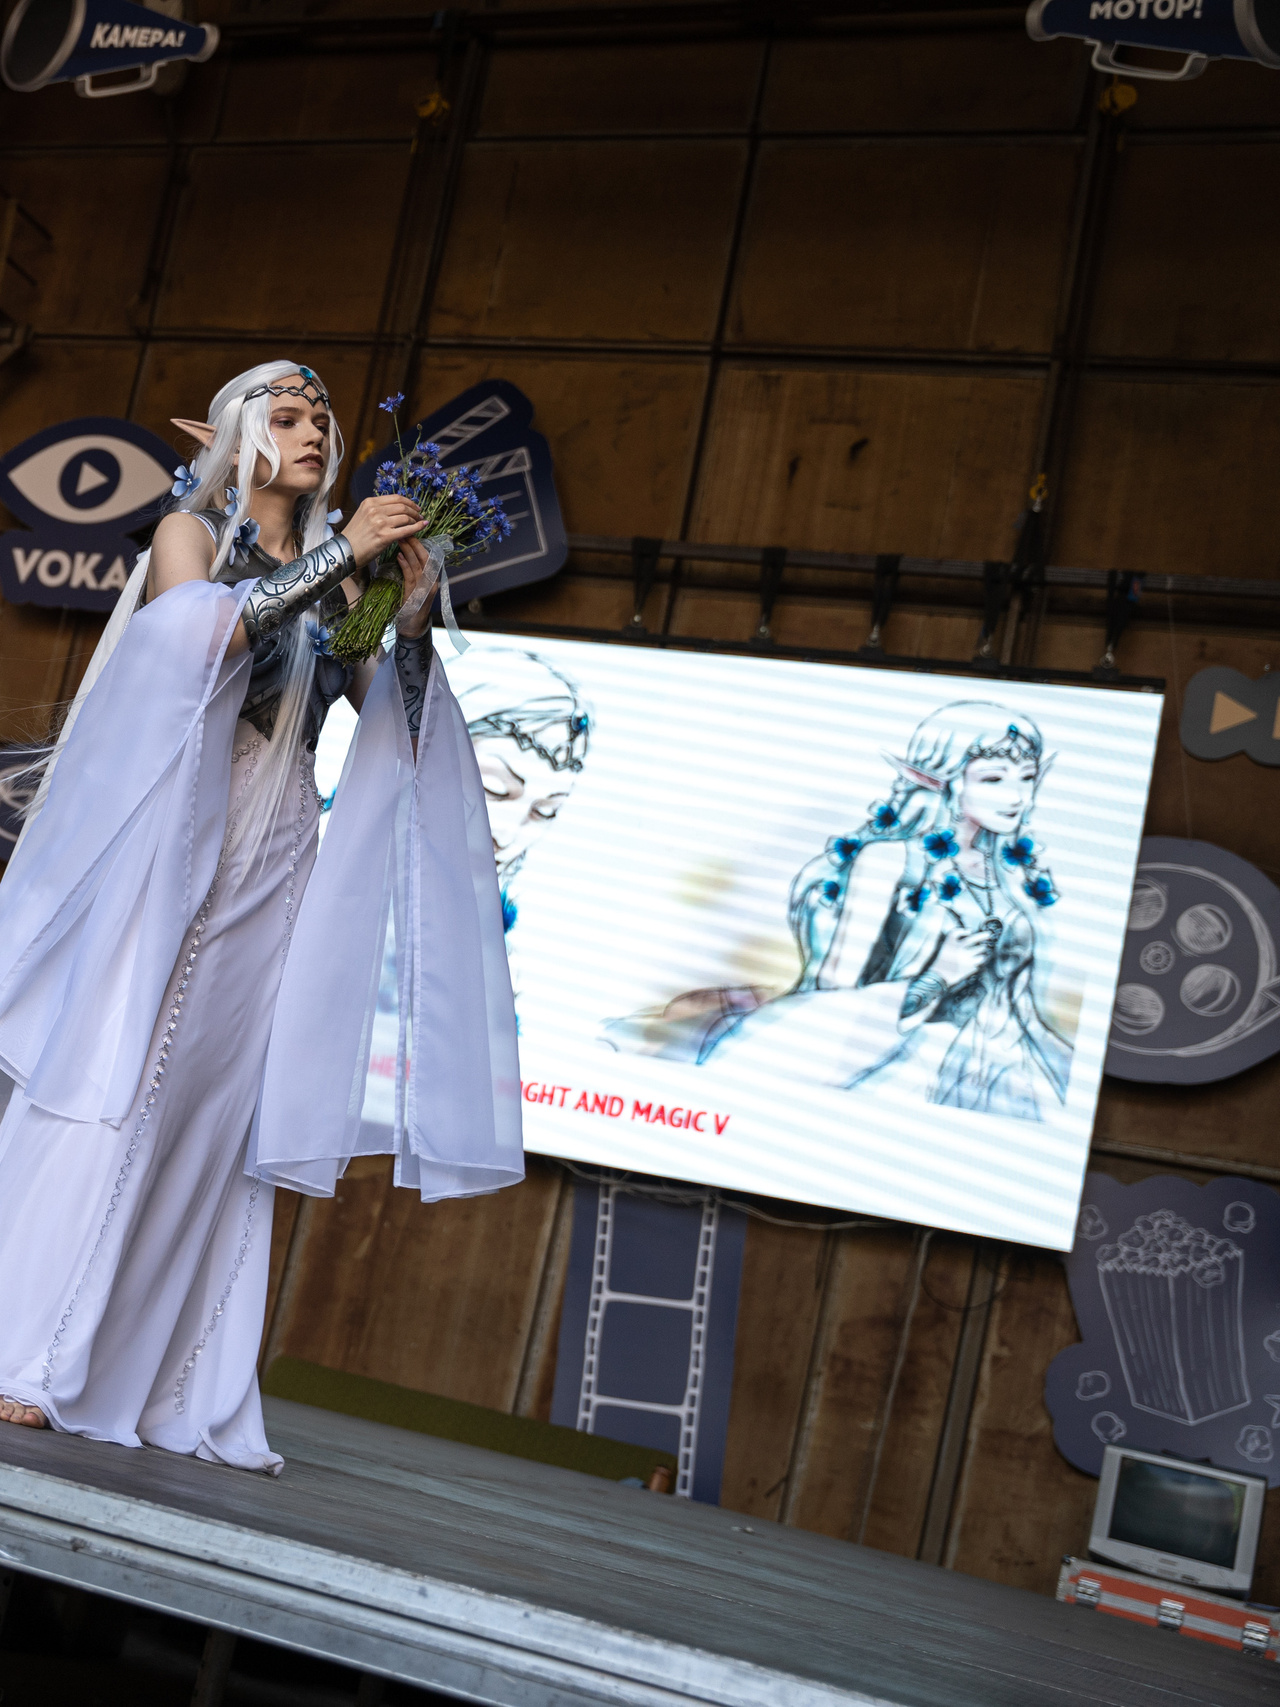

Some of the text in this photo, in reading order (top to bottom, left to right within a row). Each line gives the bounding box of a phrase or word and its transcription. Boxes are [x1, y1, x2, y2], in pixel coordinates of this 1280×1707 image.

[1088, 0, 1203, 20] МОТОР!
[89, 21, 187, 49] КАМЕРА!
[11, 546, 130, 592] VOKA
[500, 1077, 731, 1136] IGHT AND MAGIC V
